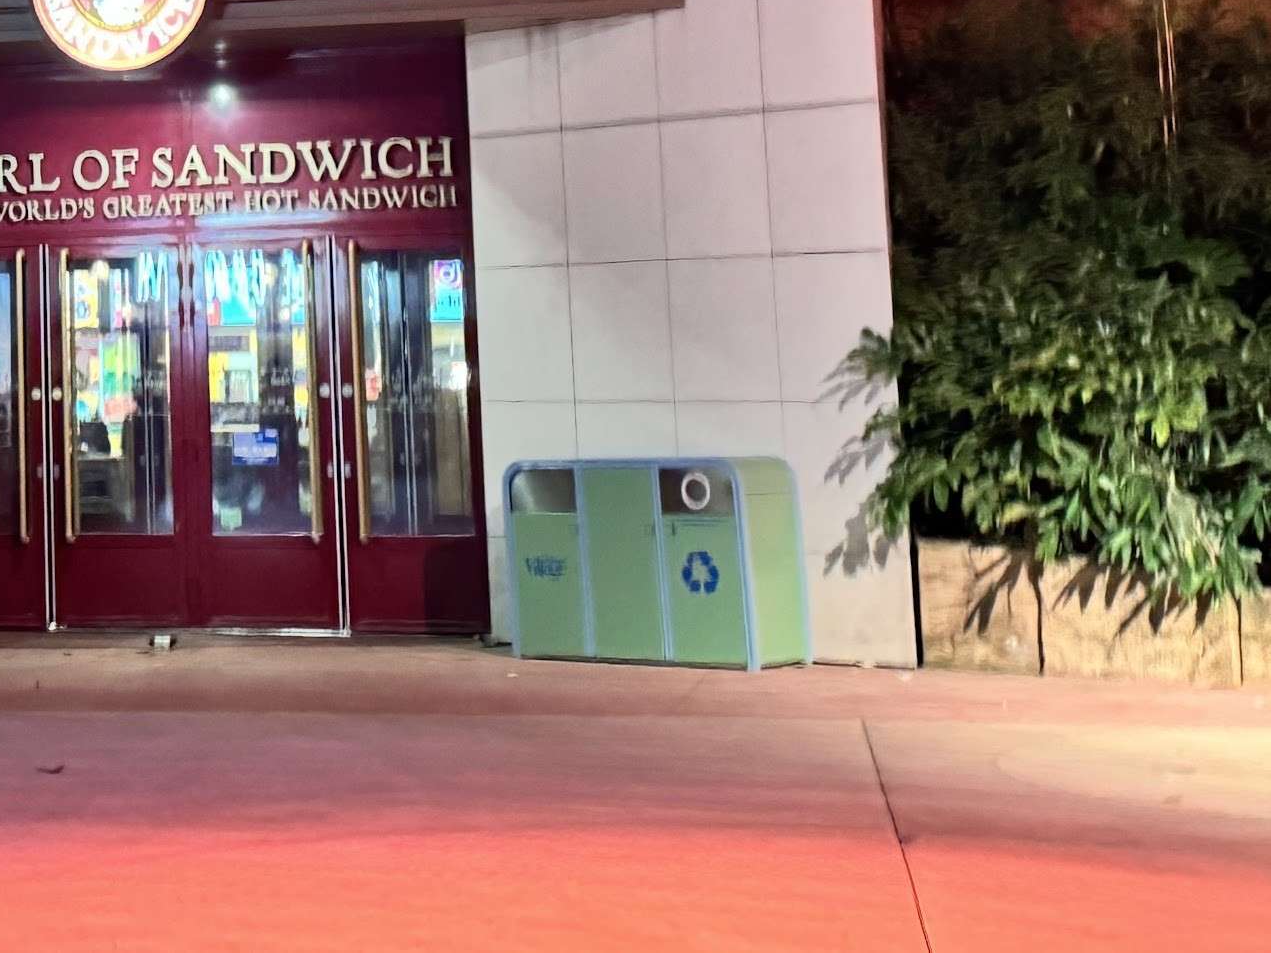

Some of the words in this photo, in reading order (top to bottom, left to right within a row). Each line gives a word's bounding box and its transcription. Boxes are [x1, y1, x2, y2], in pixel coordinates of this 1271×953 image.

[72, 148, 142, 192] OF
[150, 136, 455, 188] SANDWICH
[103, 191, 234, 219] GREATEST
[243, 188, 299, 214] HOT
[308, 184, 459, 212] SANDWICH
